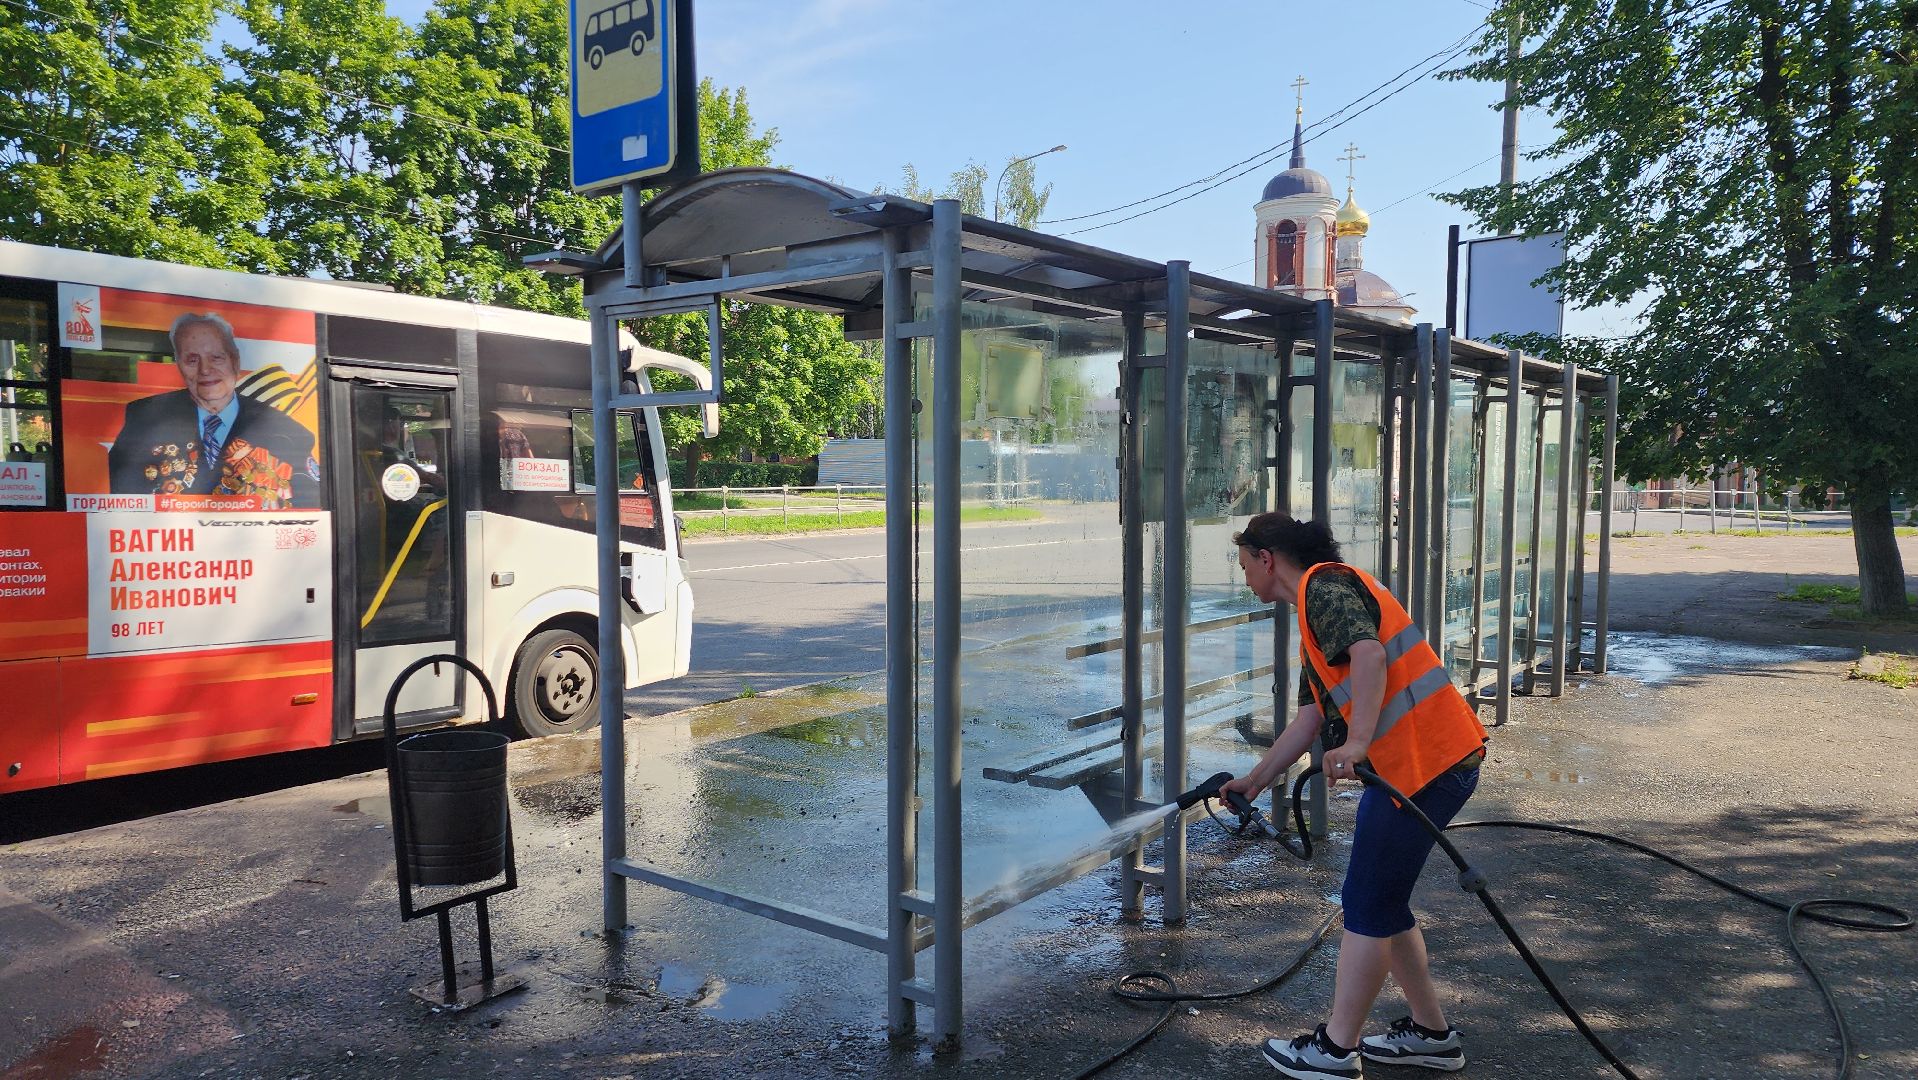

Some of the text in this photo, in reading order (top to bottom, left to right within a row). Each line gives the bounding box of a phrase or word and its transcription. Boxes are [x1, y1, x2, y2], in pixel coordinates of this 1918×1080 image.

[518, 461, 560, 473] ВОКЗАЛ
[73, 497, 149, 511] ГОРДИМСЯ!
[198, 519, 265, 527] VECTOR
[110, 528, 194, 553] ВАГИН
[109, 557, 253, 582] Александр
[110, 585, 237, 611] Иванович
[111, 620, 165, 638] 98 ЛЕТ
